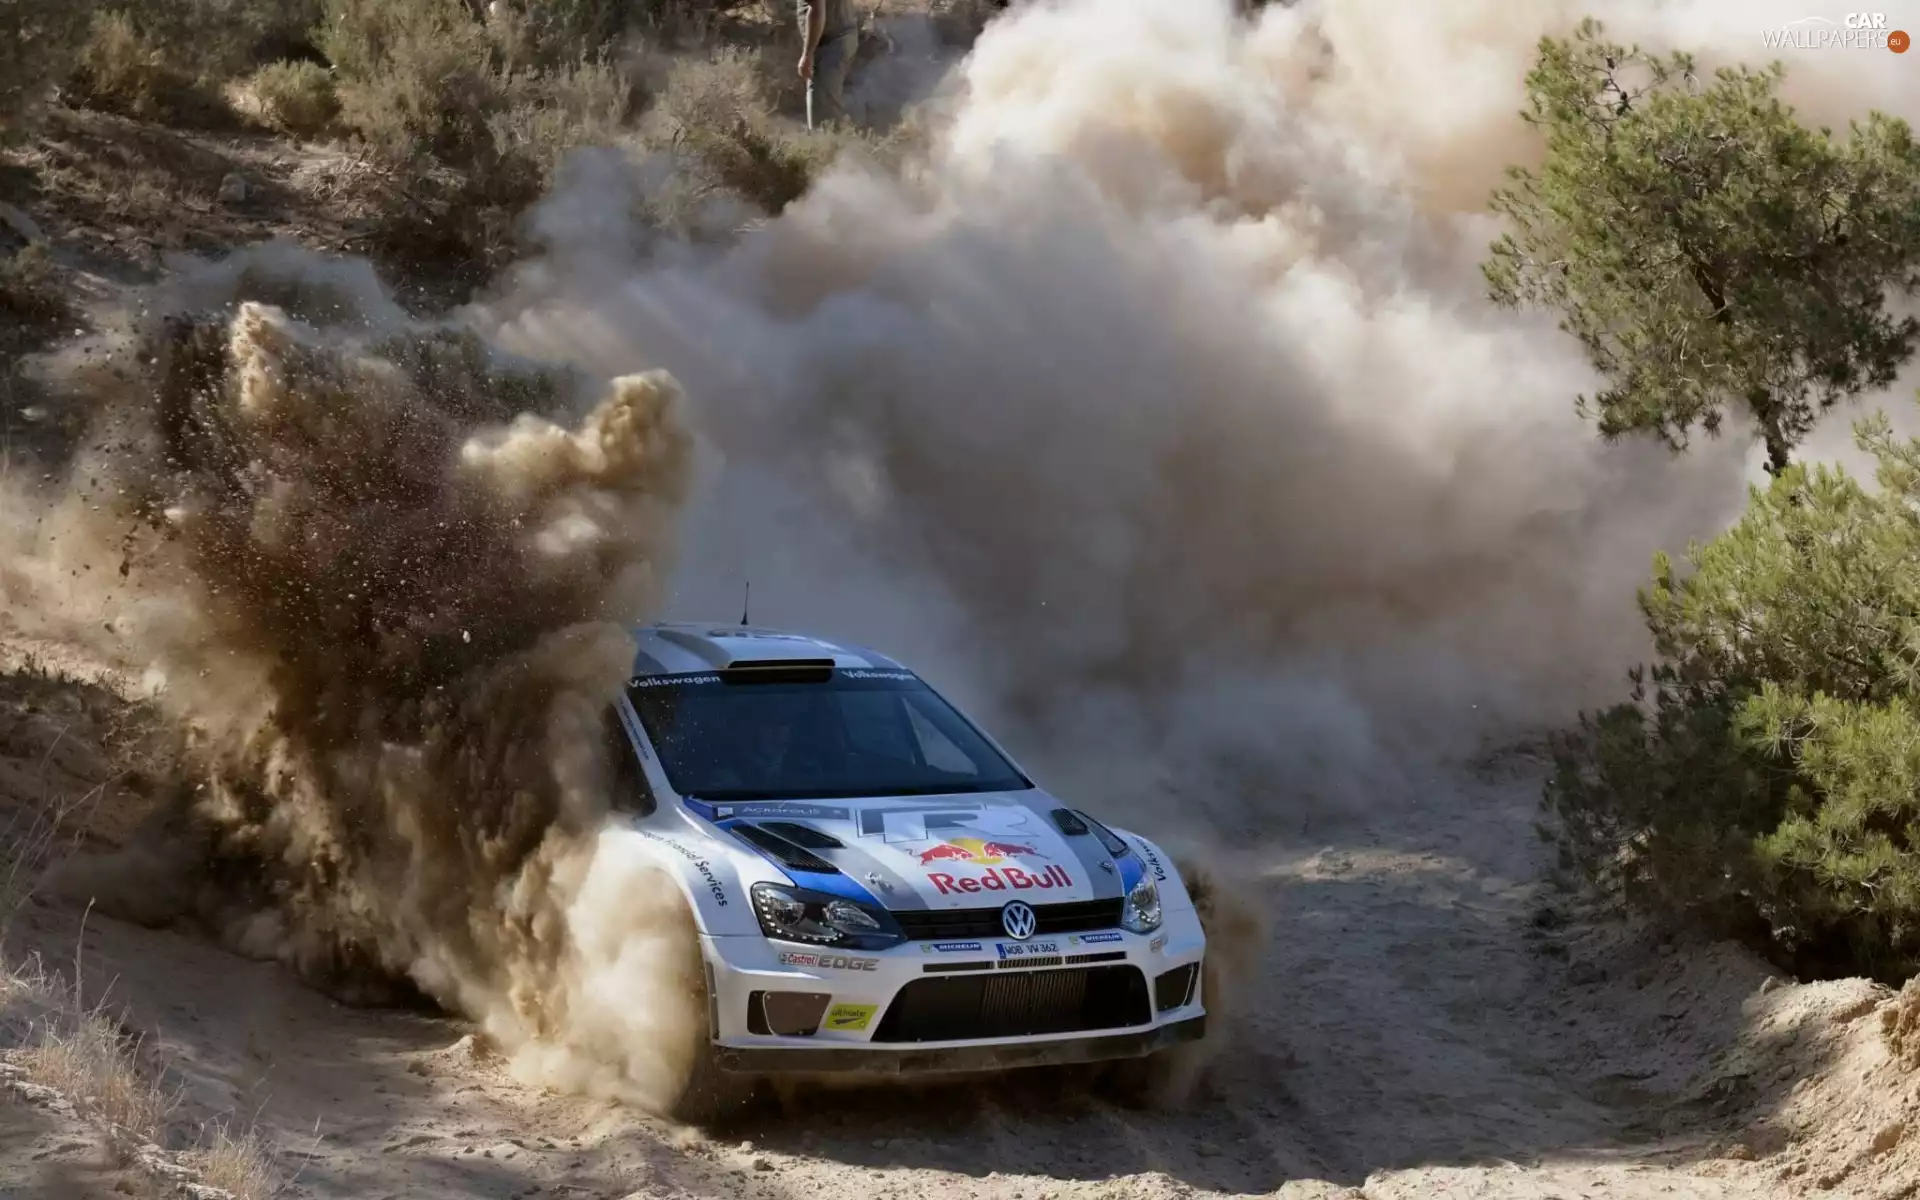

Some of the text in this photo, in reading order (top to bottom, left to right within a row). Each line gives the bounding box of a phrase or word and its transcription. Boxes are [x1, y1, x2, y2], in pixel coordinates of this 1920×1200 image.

[628, 675, 721, 688] Volkswagen
[694, 860, 728, 908] Services
[927, 864, 1073, 895] Red Bull
[938, 943, 980, 951] MICHELIN
[1004, 945, 1024, 955] WOB
[1040, 943, 1057, 953] 362
[788, 953, 879, 972] Castrol EDGE
